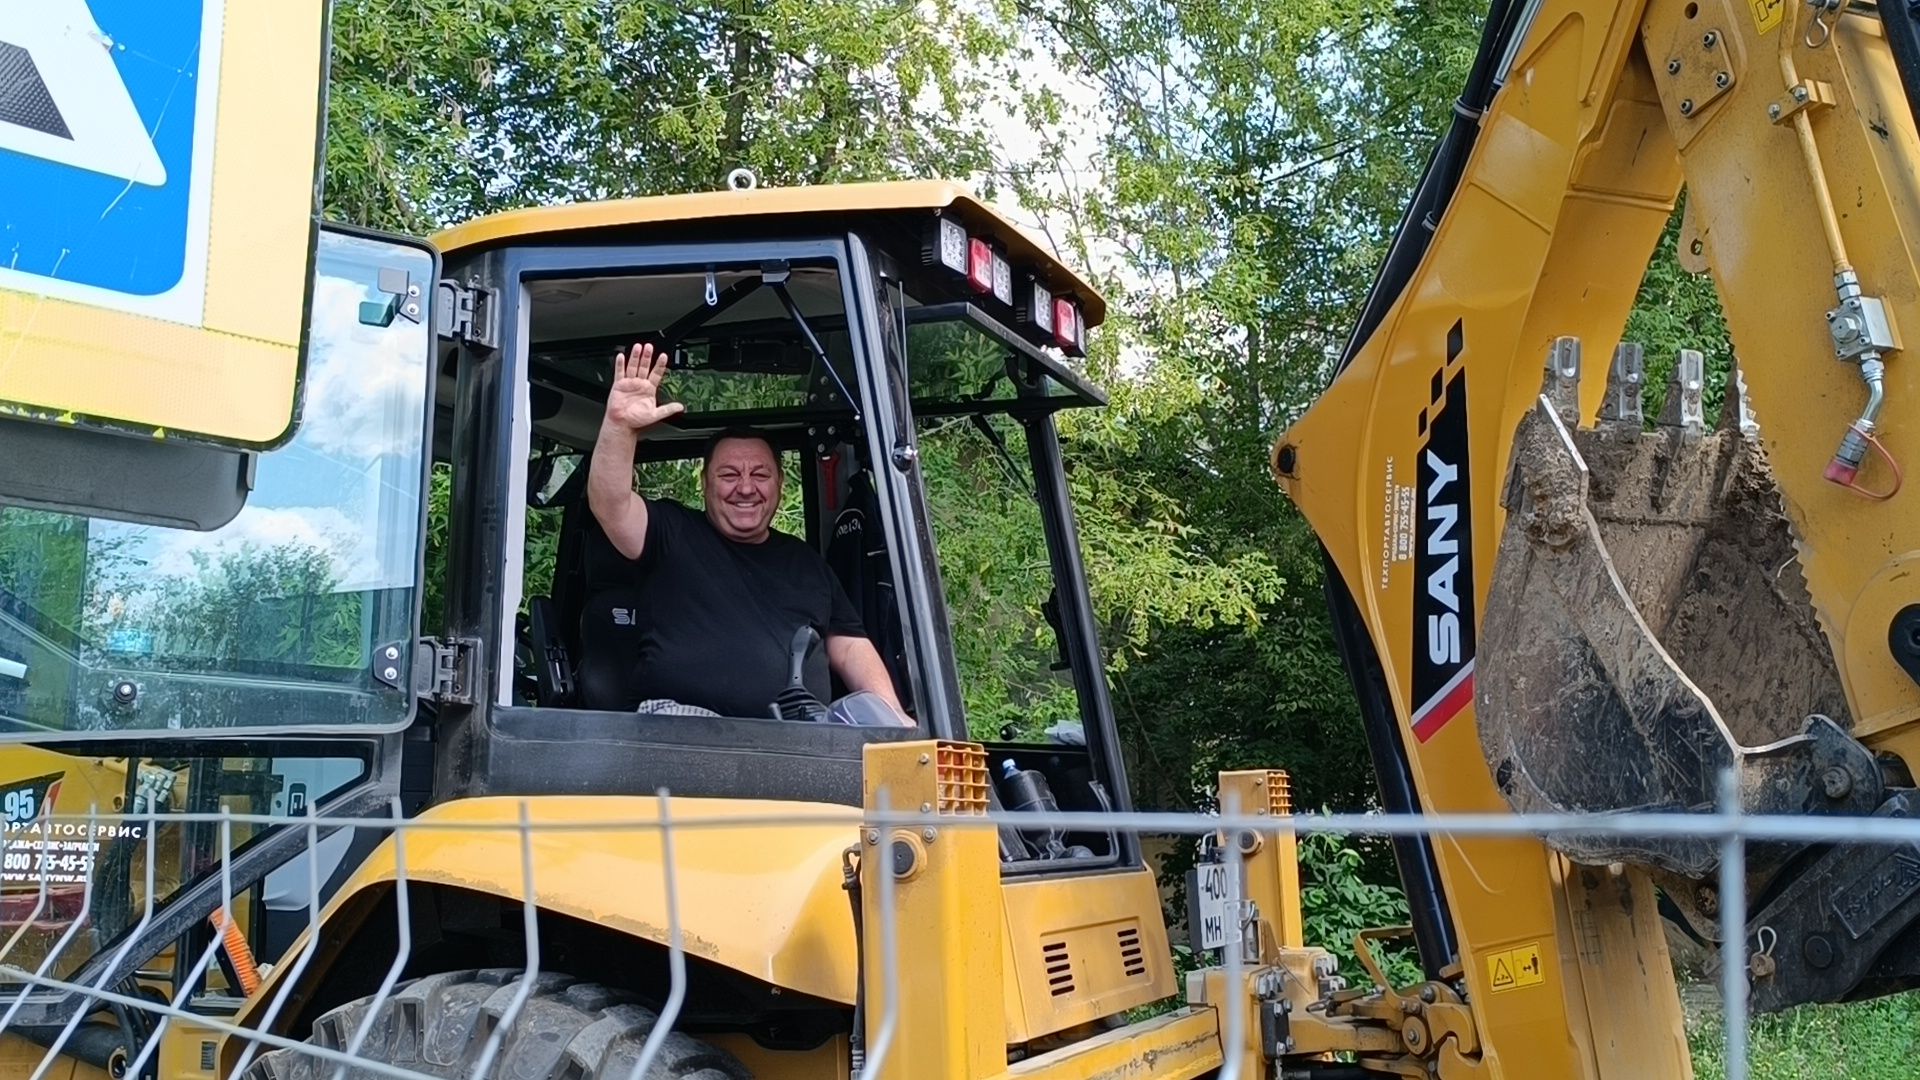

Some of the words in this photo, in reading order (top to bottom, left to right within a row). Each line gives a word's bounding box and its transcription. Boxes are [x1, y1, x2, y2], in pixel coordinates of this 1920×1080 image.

[1381, 455, 1394, 590] ТЕХПОРТАВТОСЕРВИС
[1400, 485, 1411, 530] 755-45-55
[1399, 532, 1409, 552] 800
[1427, 449, 1460, 664] SANY
[4, 787, 34, 822] 95
[3, 852, 31, 870] 800
